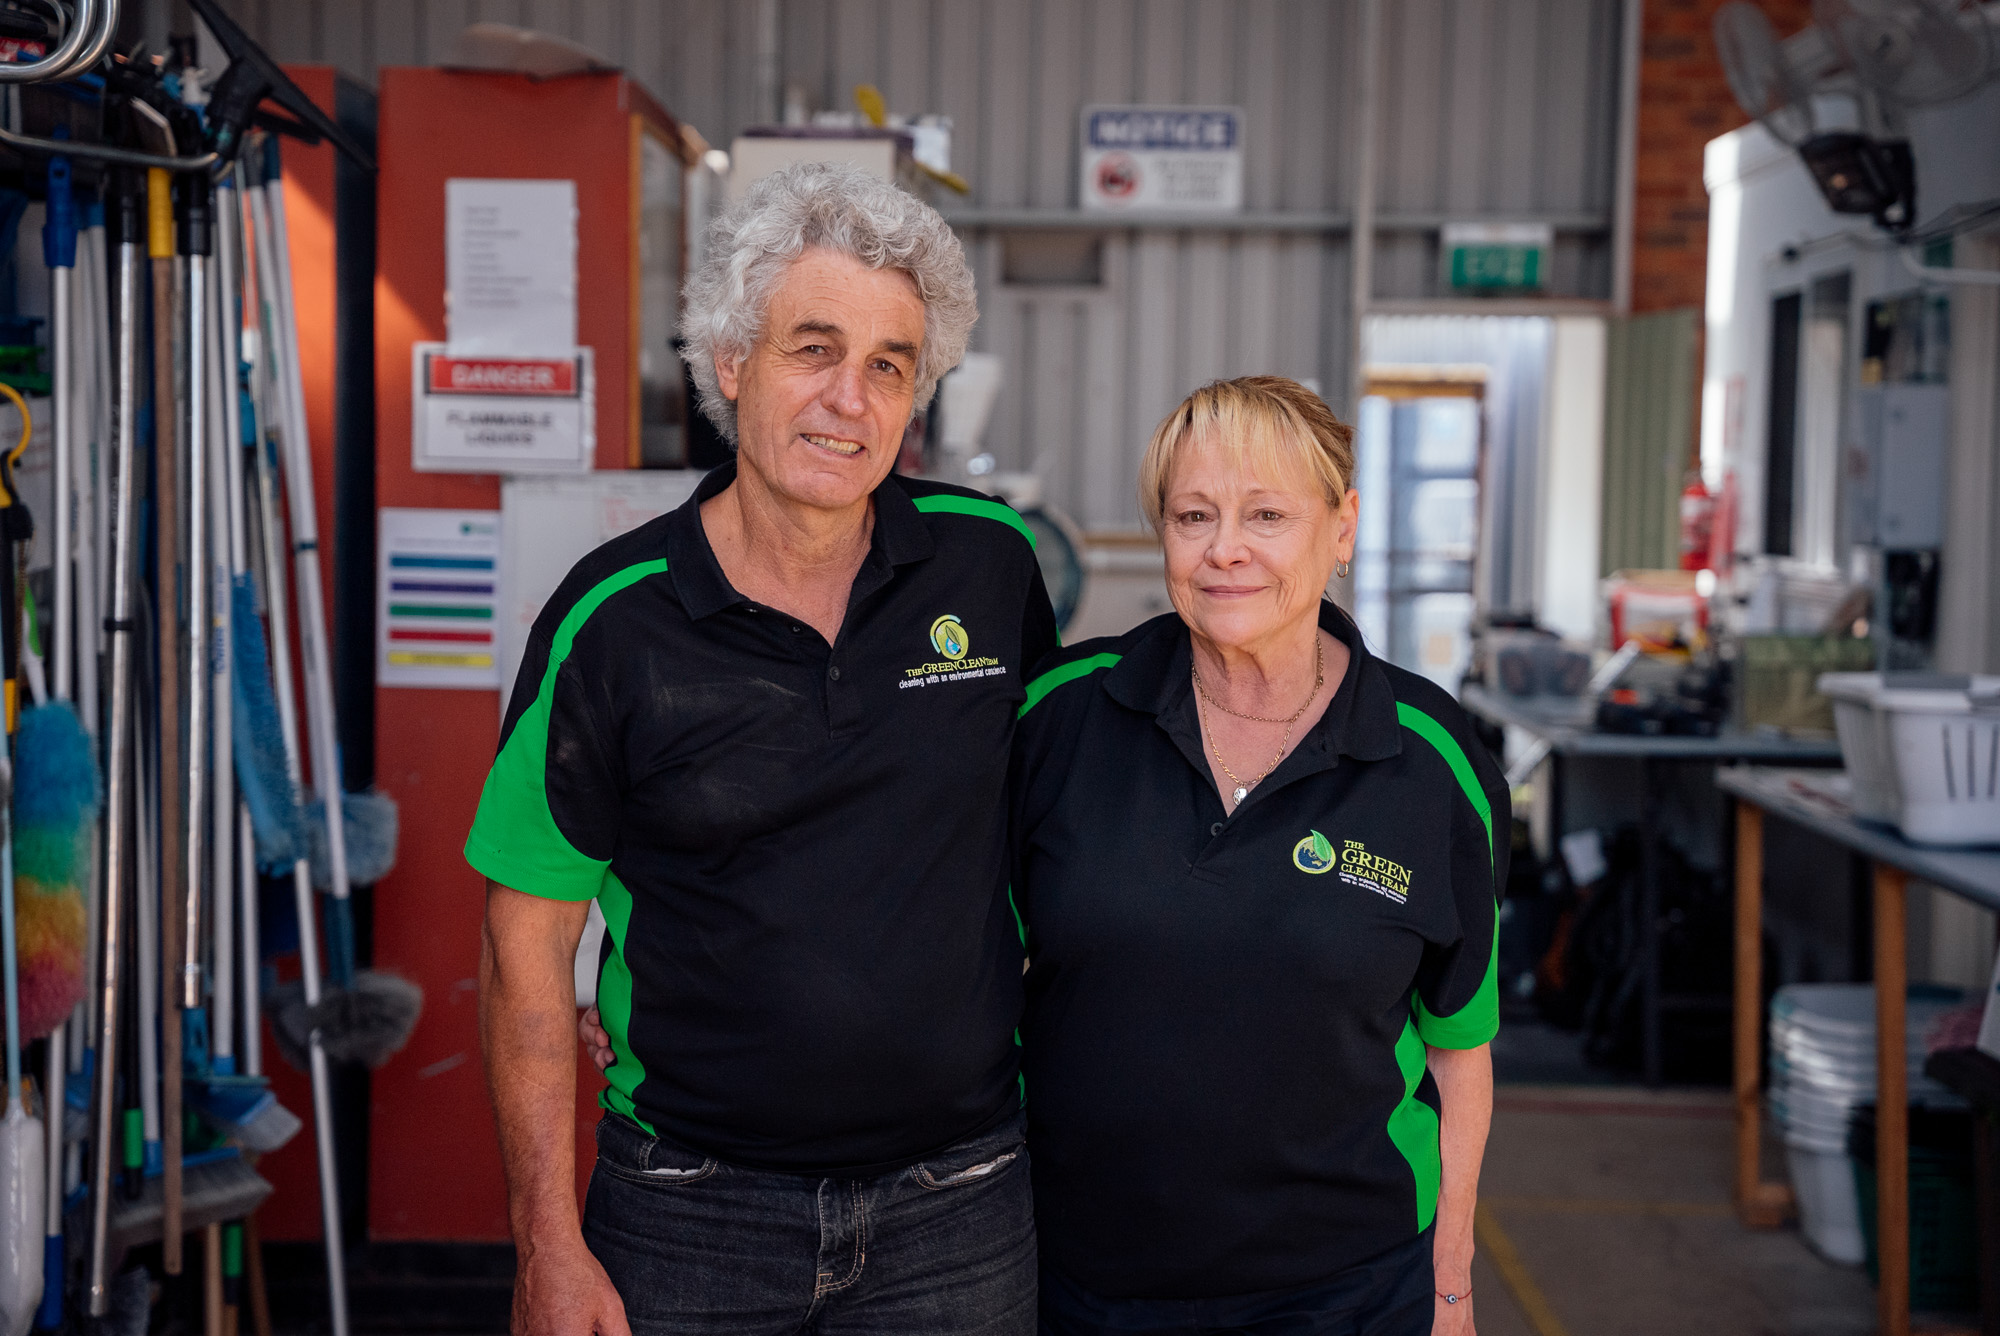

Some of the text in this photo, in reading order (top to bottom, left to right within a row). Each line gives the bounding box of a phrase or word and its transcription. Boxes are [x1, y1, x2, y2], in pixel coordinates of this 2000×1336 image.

[1099, 118, 1226, 143] NOTICE
[451, 362, 556, 388] DANGER
[446, 410, 553, 427] FLAMMABLE
[899, 677, 924, 689] cleaning
[925, 674, 939, 684] with
[940, 674, 948, 682] an
[949, 668, 984, 681] environmental
[1344, 840, 1364, 850] THE
[1342, 848, 1412, 885] GREEN
[1341, 863, 1379, 881] CLEAN
[1380, 875, 1408, 896] TEAM
